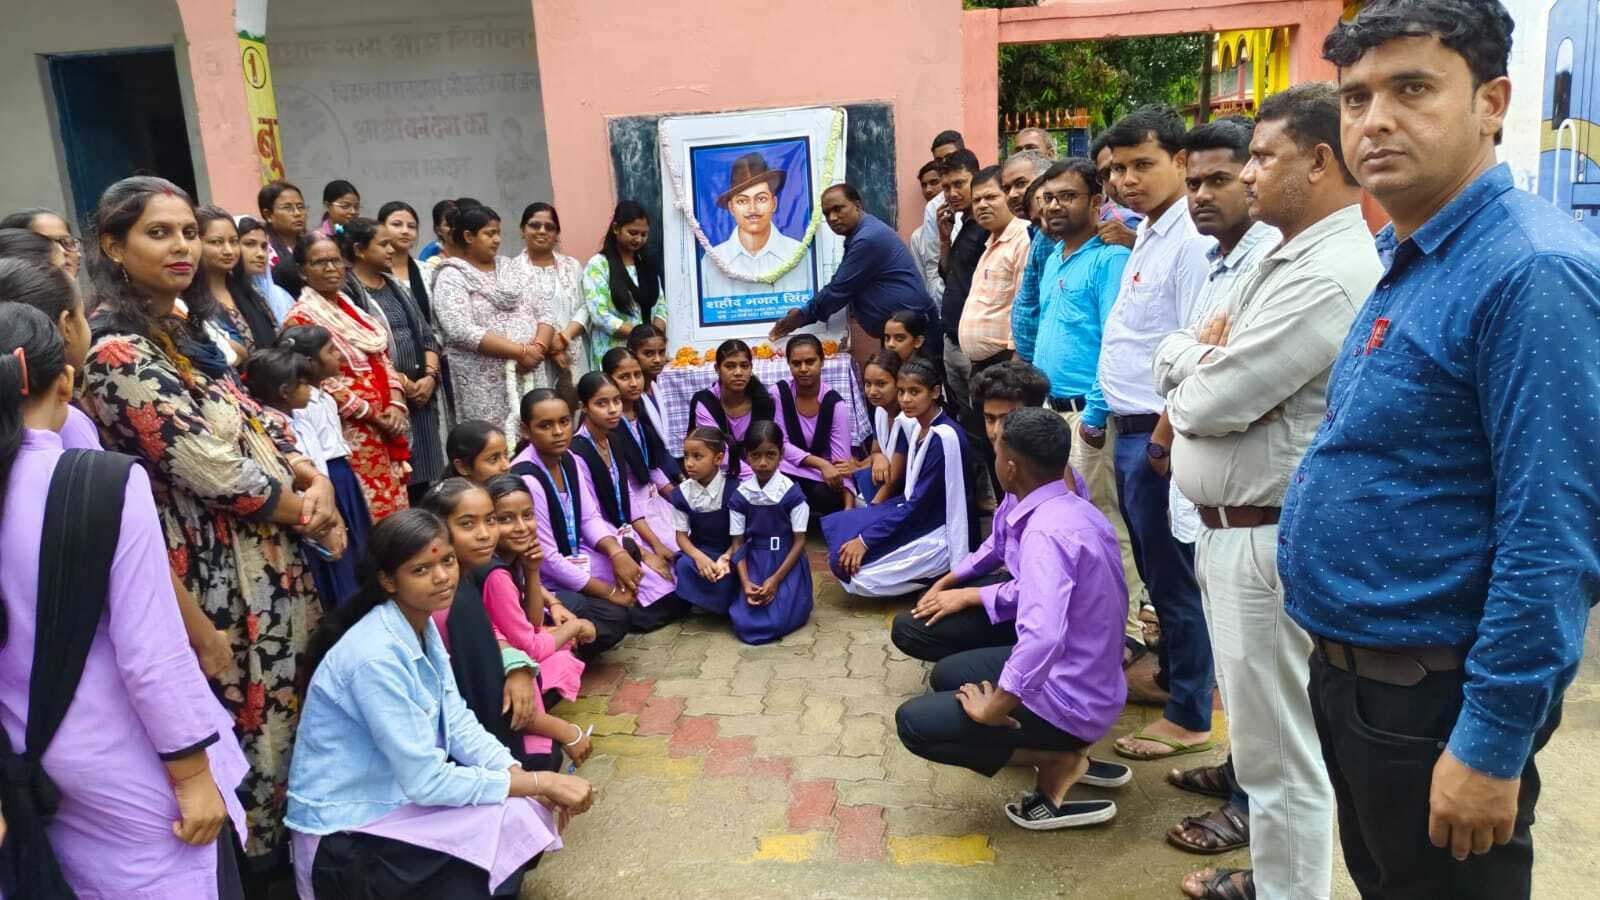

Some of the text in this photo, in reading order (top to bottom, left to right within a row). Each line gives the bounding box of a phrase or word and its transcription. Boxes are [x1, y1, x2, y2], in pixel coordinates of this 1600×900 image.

[705, 297, 741, 309] शहीद
[746, 295, 779, 306] भगत
[784, 292, 810, 304] सिंह
